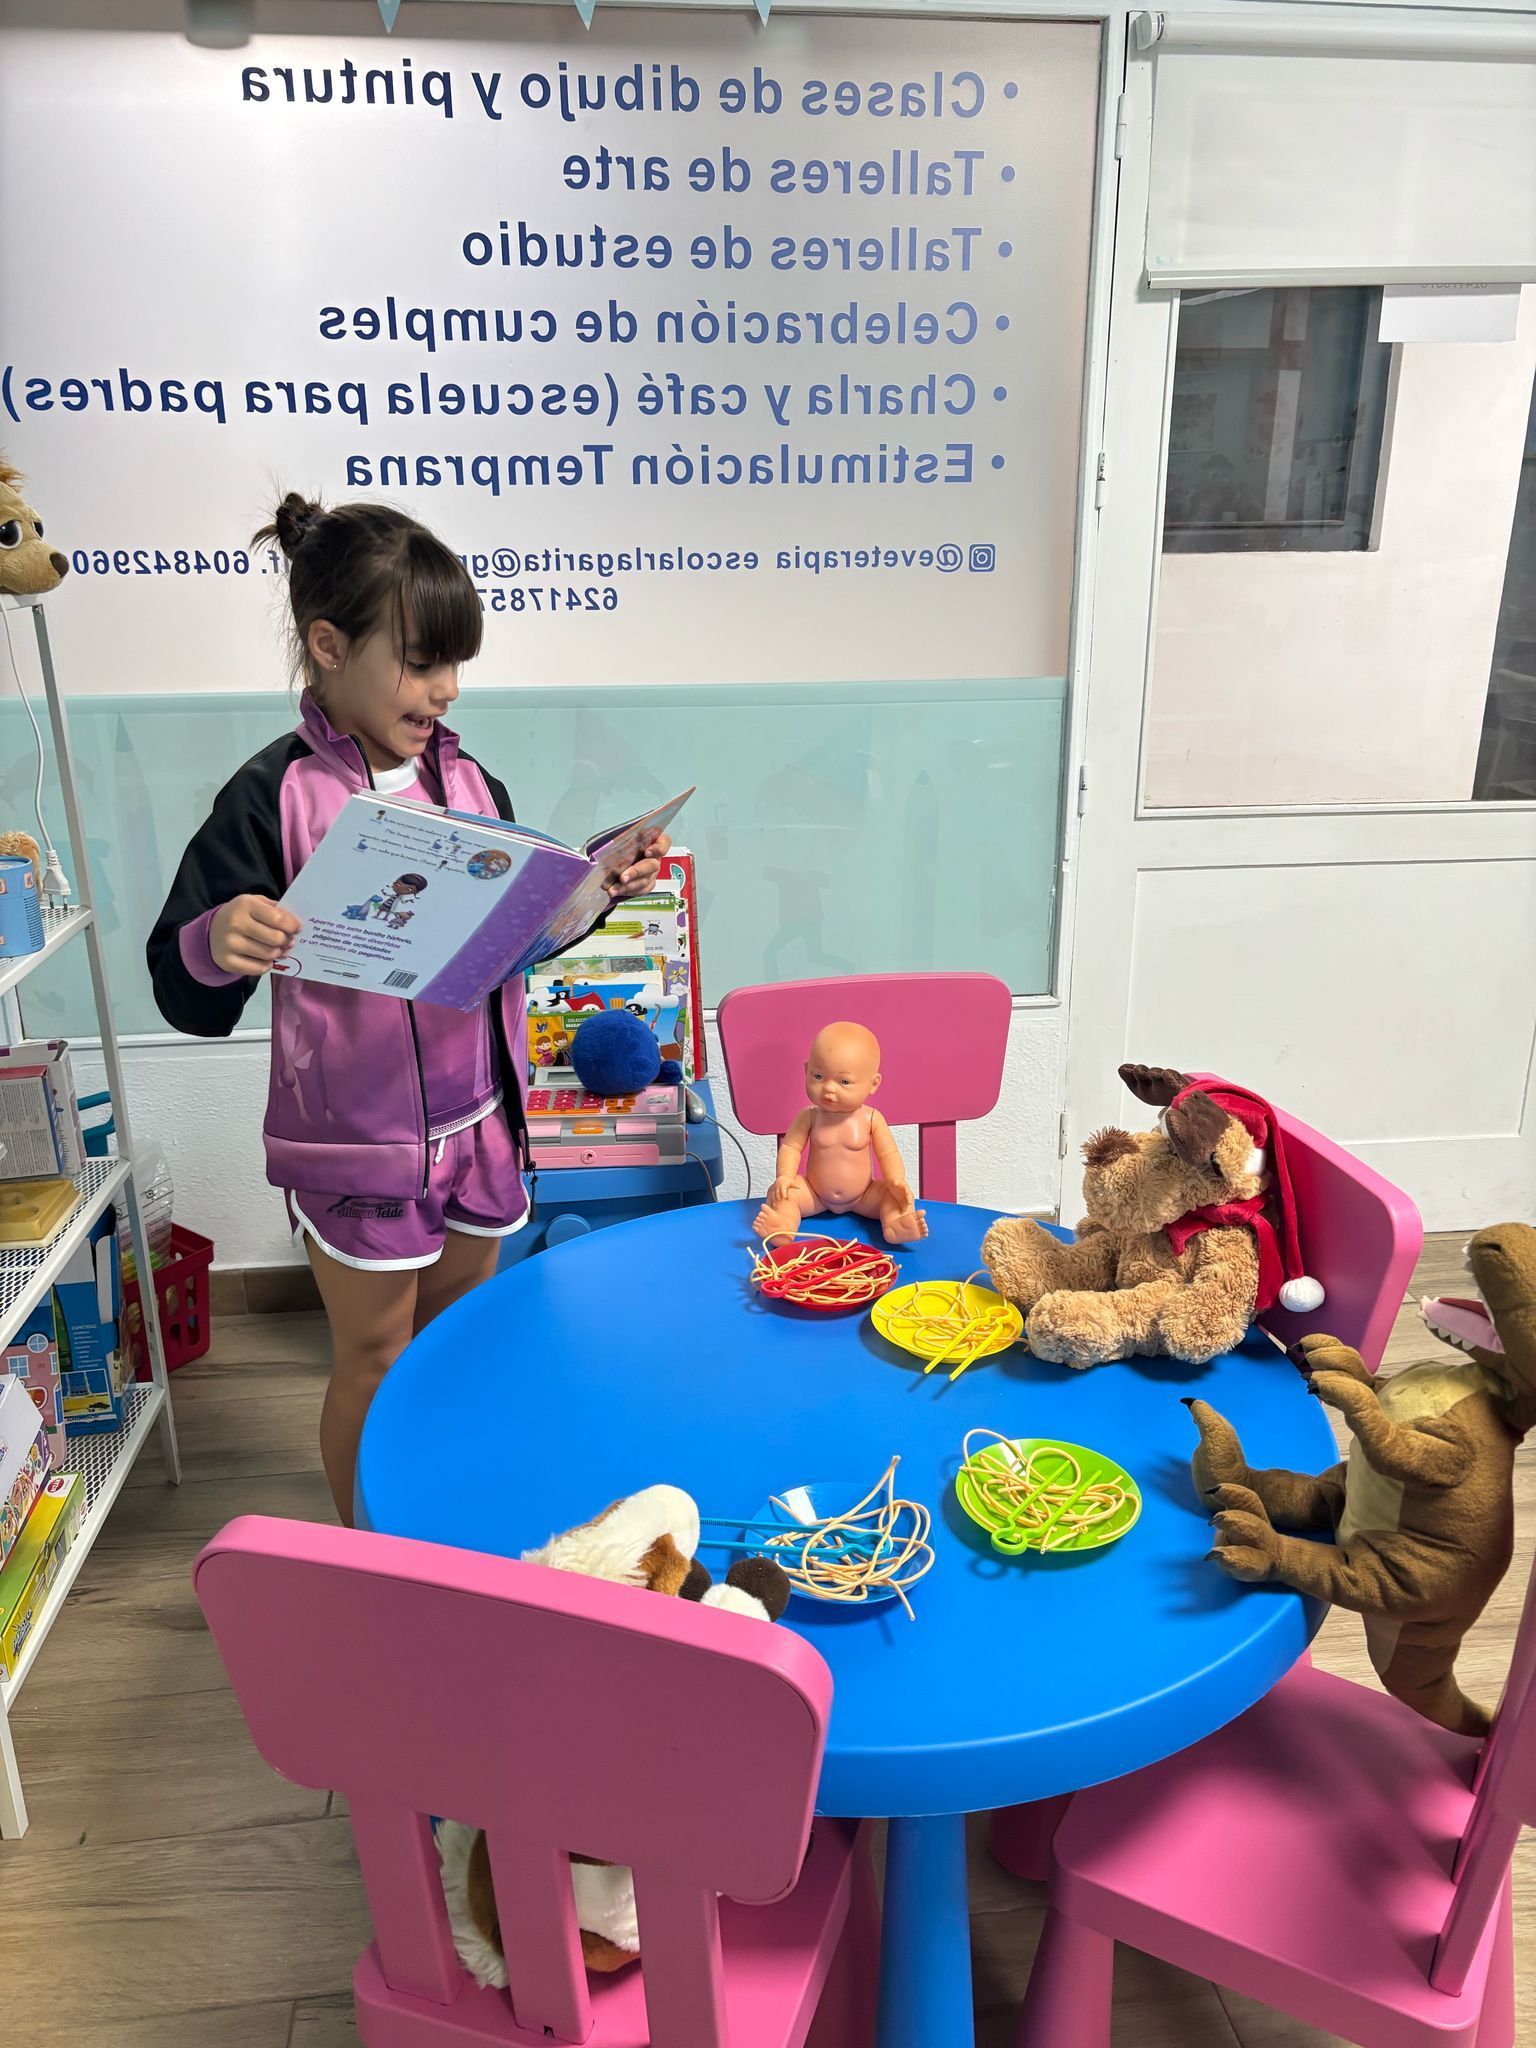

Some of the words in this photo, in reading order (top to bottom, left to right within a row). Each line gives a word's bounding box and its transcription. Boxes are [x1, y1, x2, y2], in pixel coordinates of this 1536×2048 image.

[308, 917, 335, 928] Aparte
[363, 929, 385, 939] bonita
[312, 933, 341, 944] páginas
[353, 941, 392, 954] actividades
